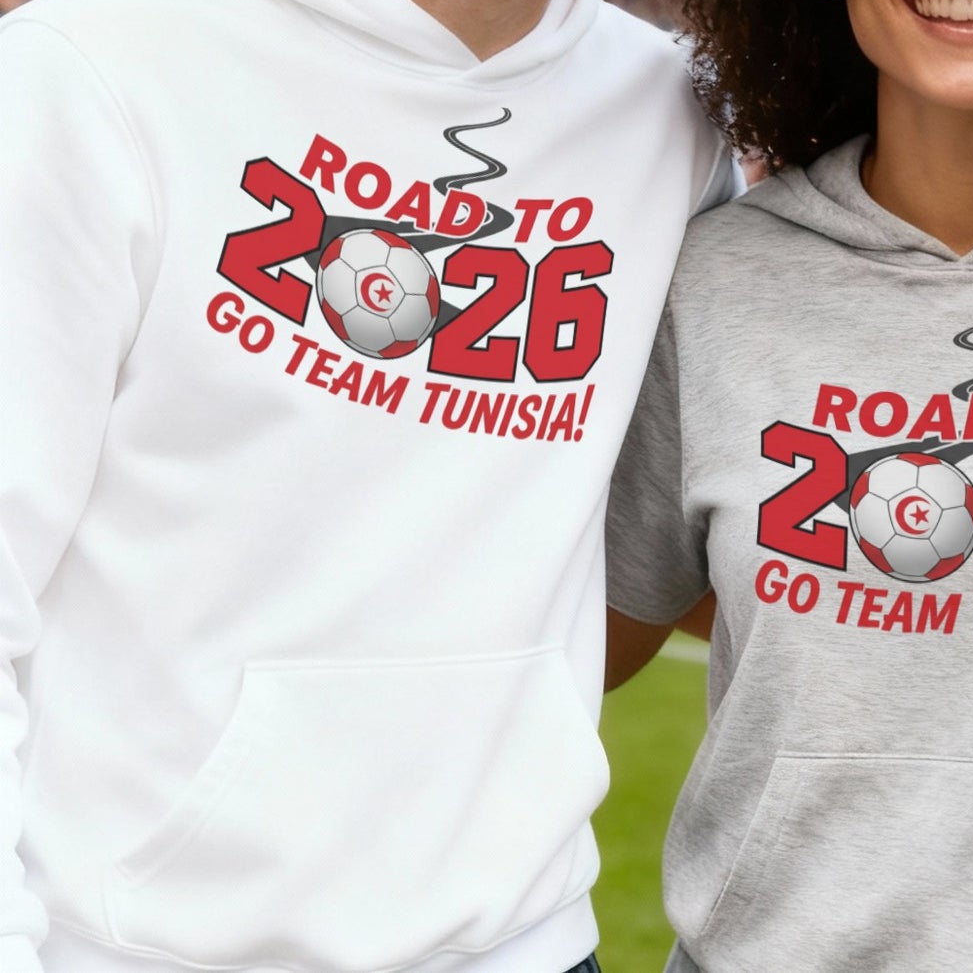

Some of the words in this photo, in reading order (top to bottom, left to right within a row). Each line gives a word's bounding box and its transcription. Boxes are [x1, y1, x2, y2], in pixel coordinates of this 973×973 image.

[299, 133, 487, 237] ROAD
[513, 197, 594, 243] TO
[206, 292, 275, 354] GO
[284, 334, 409, 414] TEAM
[419, 383, 596, 443] TUNISIA!
[754, 559, 820, 614] GO
[836, 581, 962, 634] TEAM
